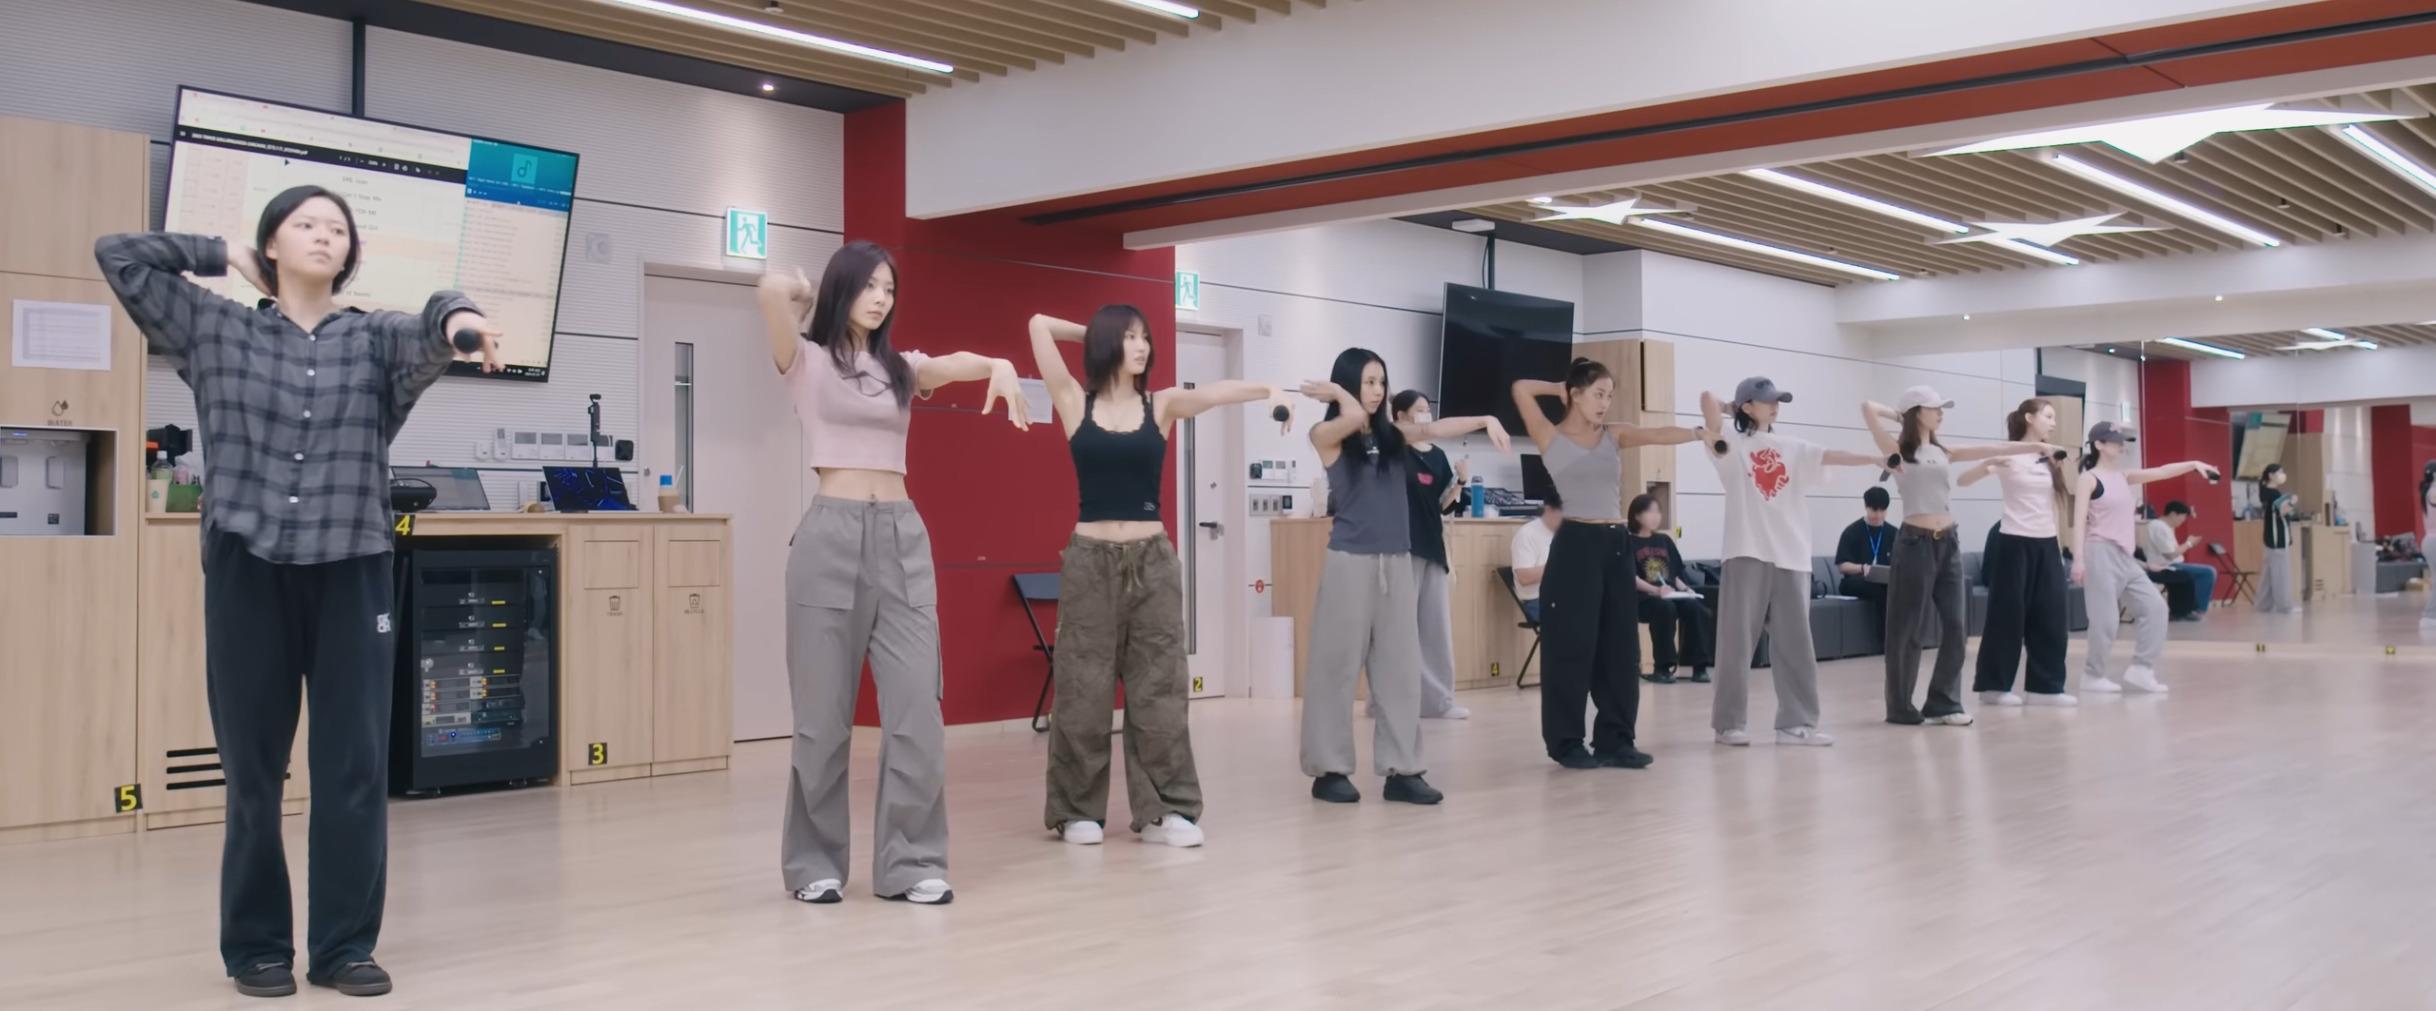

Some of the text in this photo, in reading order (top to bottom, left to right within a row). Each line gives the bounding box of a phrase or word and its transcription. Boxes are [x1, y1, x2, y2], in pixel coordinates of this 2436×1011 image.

[395, 514, 410, 535] 4
[1194, 677, 1202, 692] 2
[592, 743, 604, 764] 3
[120, 785, 137, 810] 5
